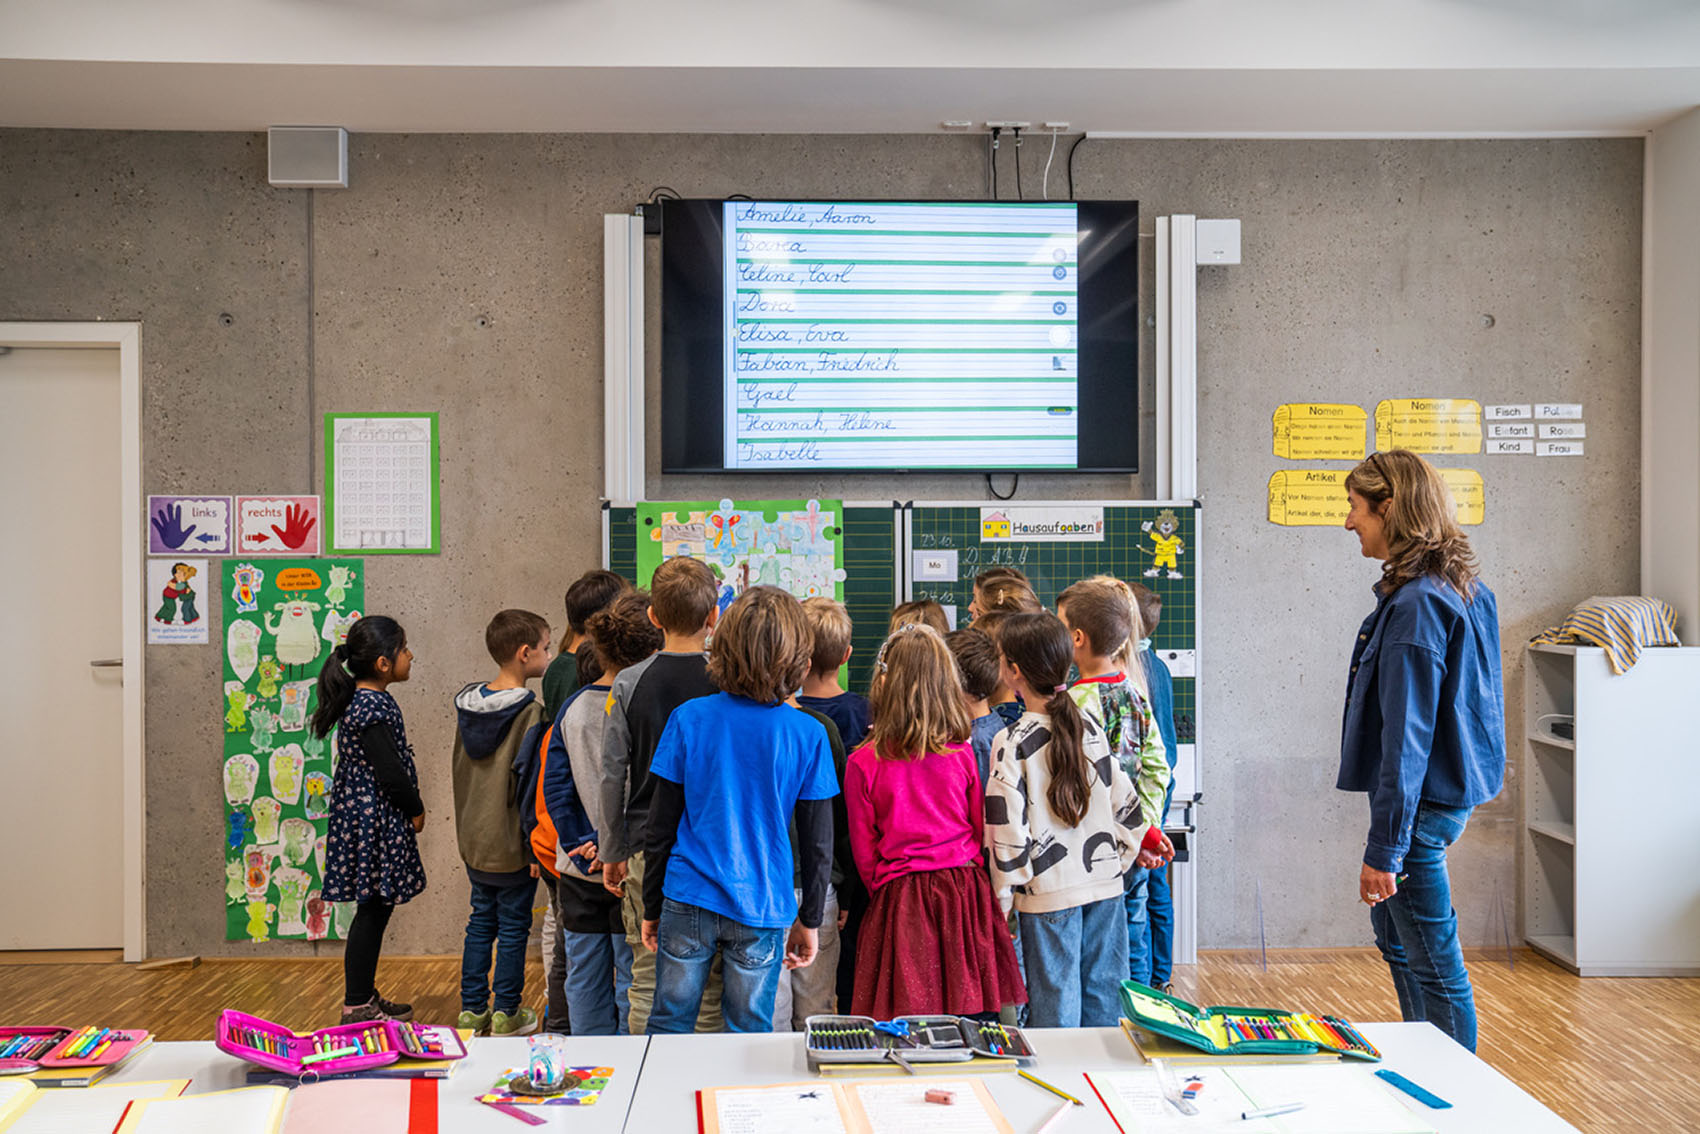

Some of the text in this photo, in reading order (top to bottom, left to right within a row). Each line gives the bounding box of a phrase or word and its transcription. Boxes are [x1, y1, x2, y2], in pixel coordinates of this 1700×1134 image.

[739, 291, 795, 312] Dora
[806, 323, 849, 342] Eva
[1309, 406, 1344, 415] Nomen
[1411, 401, 1446, 411] Nomen
[1496, 407, 1521, 416] Fisch
[1495, 426, 1528, 436] Efant
[743, 441, 822, 461] Isabelle
[1499, 442, 1521, 452] Kind
[1548, 444, 1571, 454] Frau
[1305, 472, 1337, 482] Artikel
[192, 507, 217, 517] links
[247, 506, 282, 517] rechts
[1013, 521, 1094, 535] Hausaufgaben
[928, 561, 942, 569] Mo
